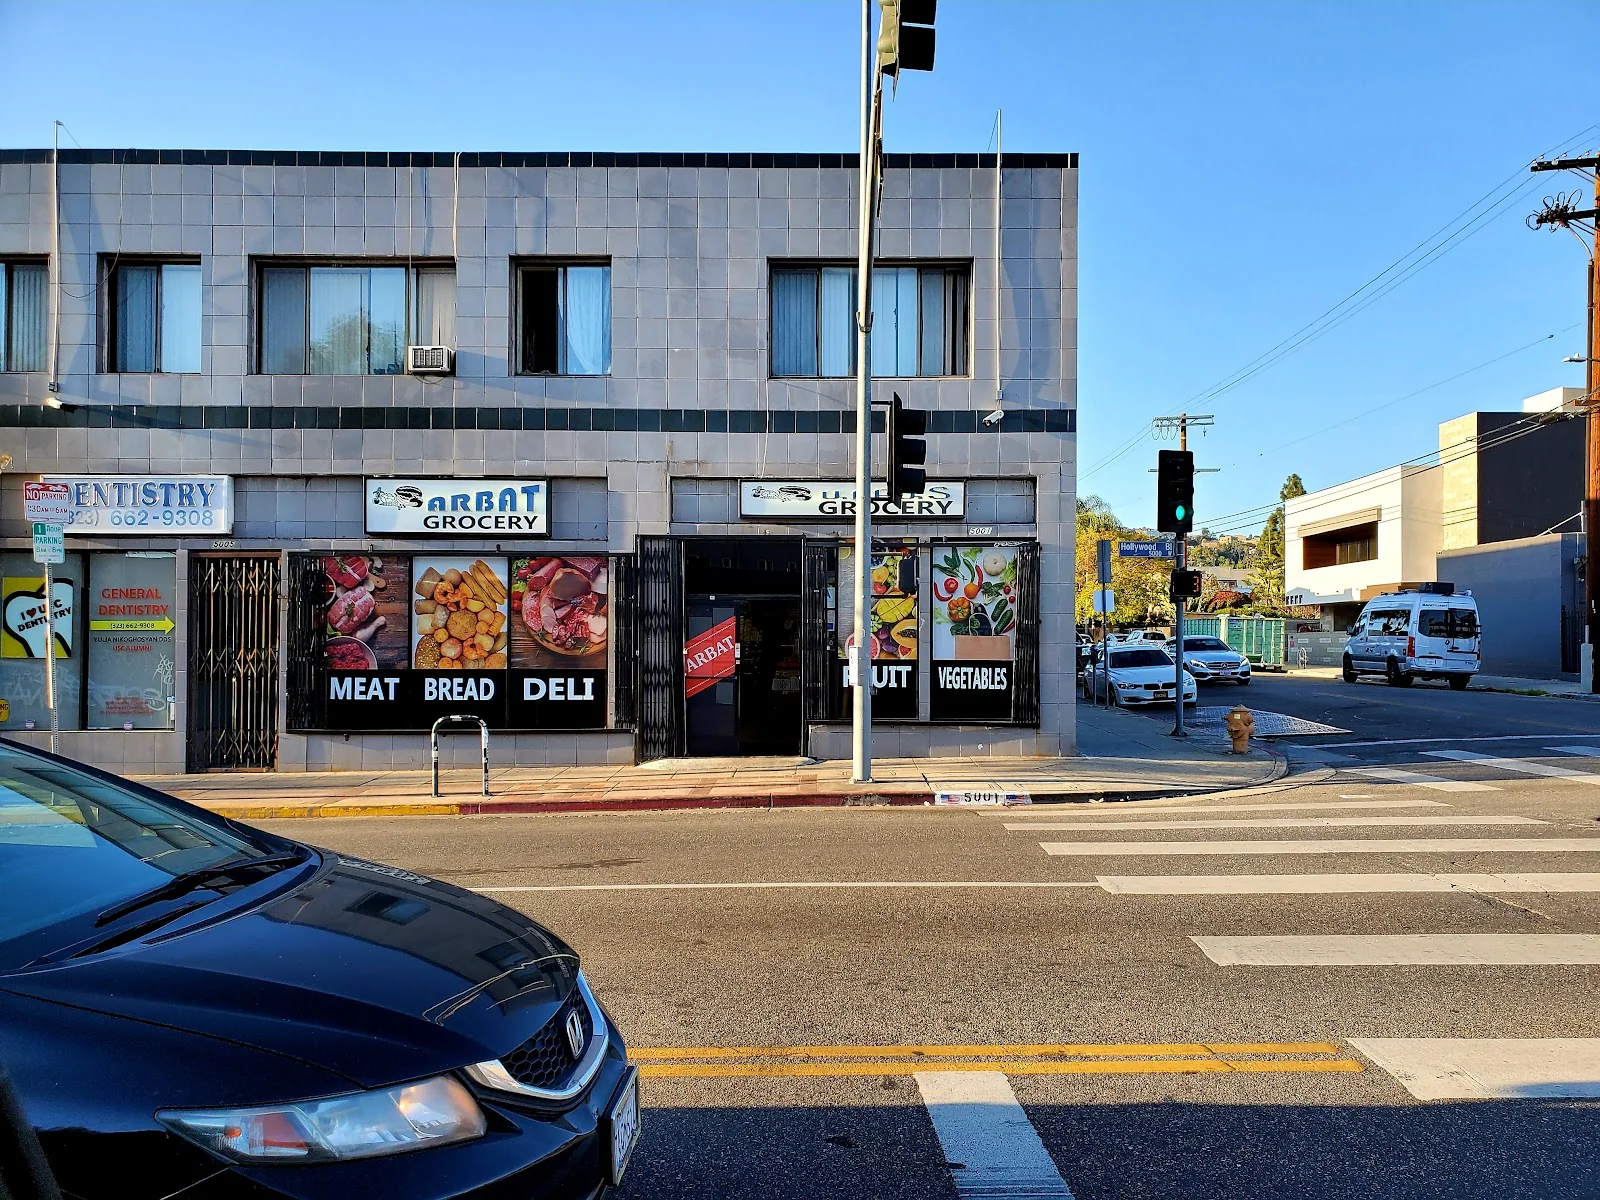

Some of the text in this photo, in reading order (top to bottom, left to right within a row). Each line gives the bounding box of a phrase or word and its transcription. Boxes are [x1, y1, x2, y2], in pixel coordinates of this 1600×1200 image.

[26, 489, 67, 500] NO PARKING
[427, 484, 540, 513] ARBAT
[55, 506, 68, 514] 6AM
[110, 509, 214, 526] 662-9308
[423, 515, 539, 530] GROCERY
[970, 526, 993, 536] 5001
[35, 536, 62, 545] PARKING
[1120, 542, 1157, 553] Hollywood
[101, 588, 162, 600] GENERAL
[37, 599, 63, 614] UC
[98, 604, 169, 616] DENTISTRY
[17, 606, 72, 632] DENTITRY
[686, 635, 735, 673] ARBAT
[842, 665, 912, 689] FUIT
[937, 666, 1008, 691] VEGETABLES
[329, 677, 400, 700] MEAT
[424, 677, 495, 701] BREAD
[523, 677, 594, 700] DELI
[964, 792, 999, 803] 5001
